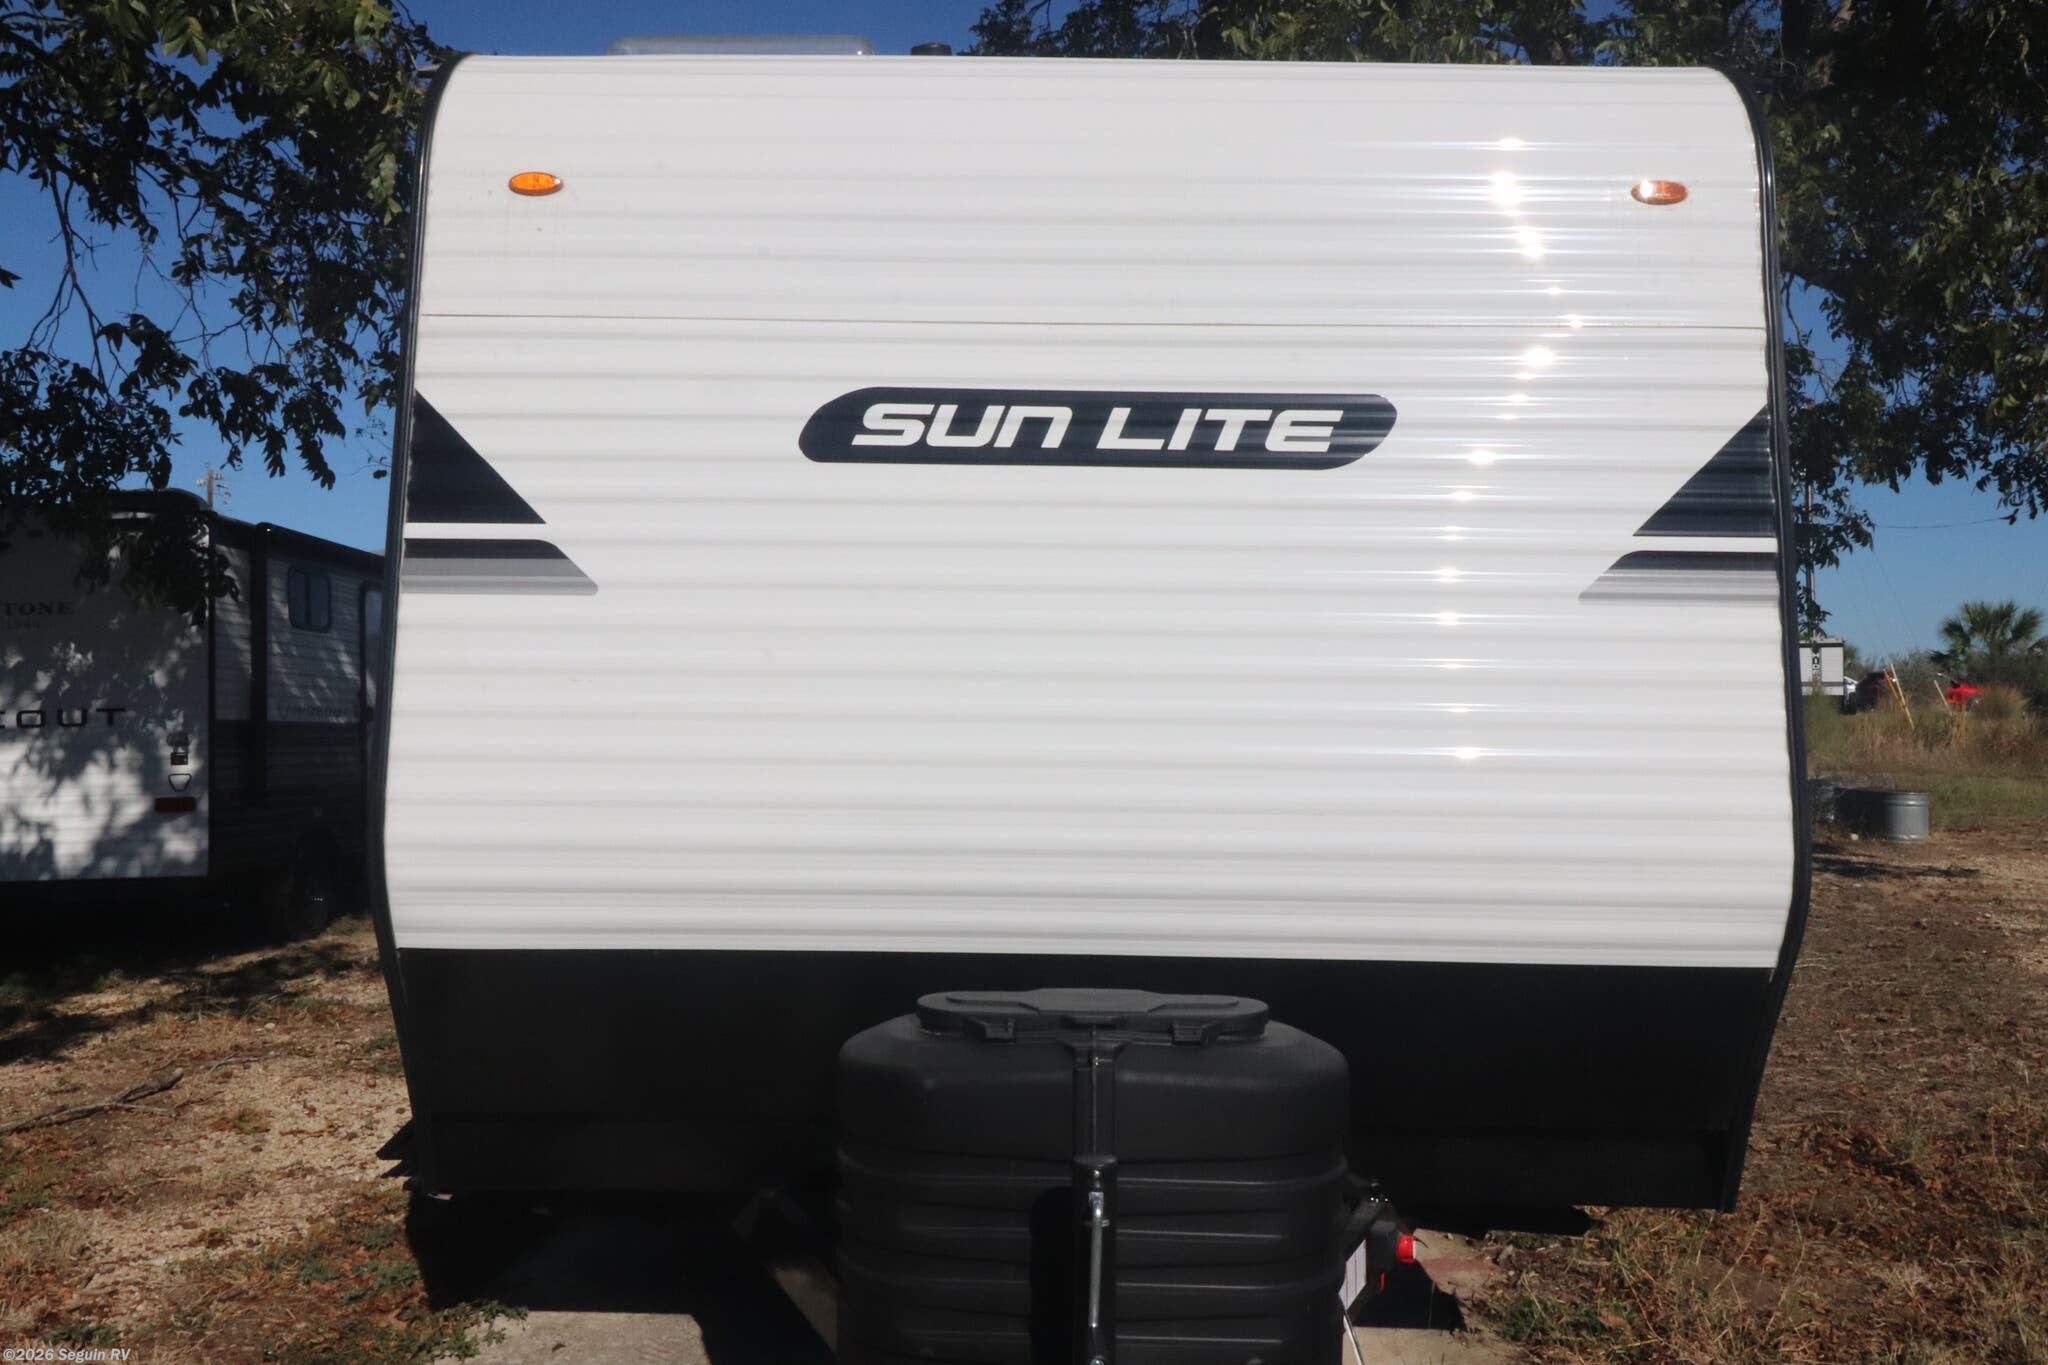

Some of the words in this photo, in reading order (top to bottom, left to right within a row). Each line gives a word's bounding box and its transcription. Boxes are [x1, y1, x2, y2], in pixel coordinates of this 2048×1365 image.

[851, 403, 1073, 449] SUN
[1096, 407, 1345, 452] LITE
[0, 707, 126, 729] OUT
